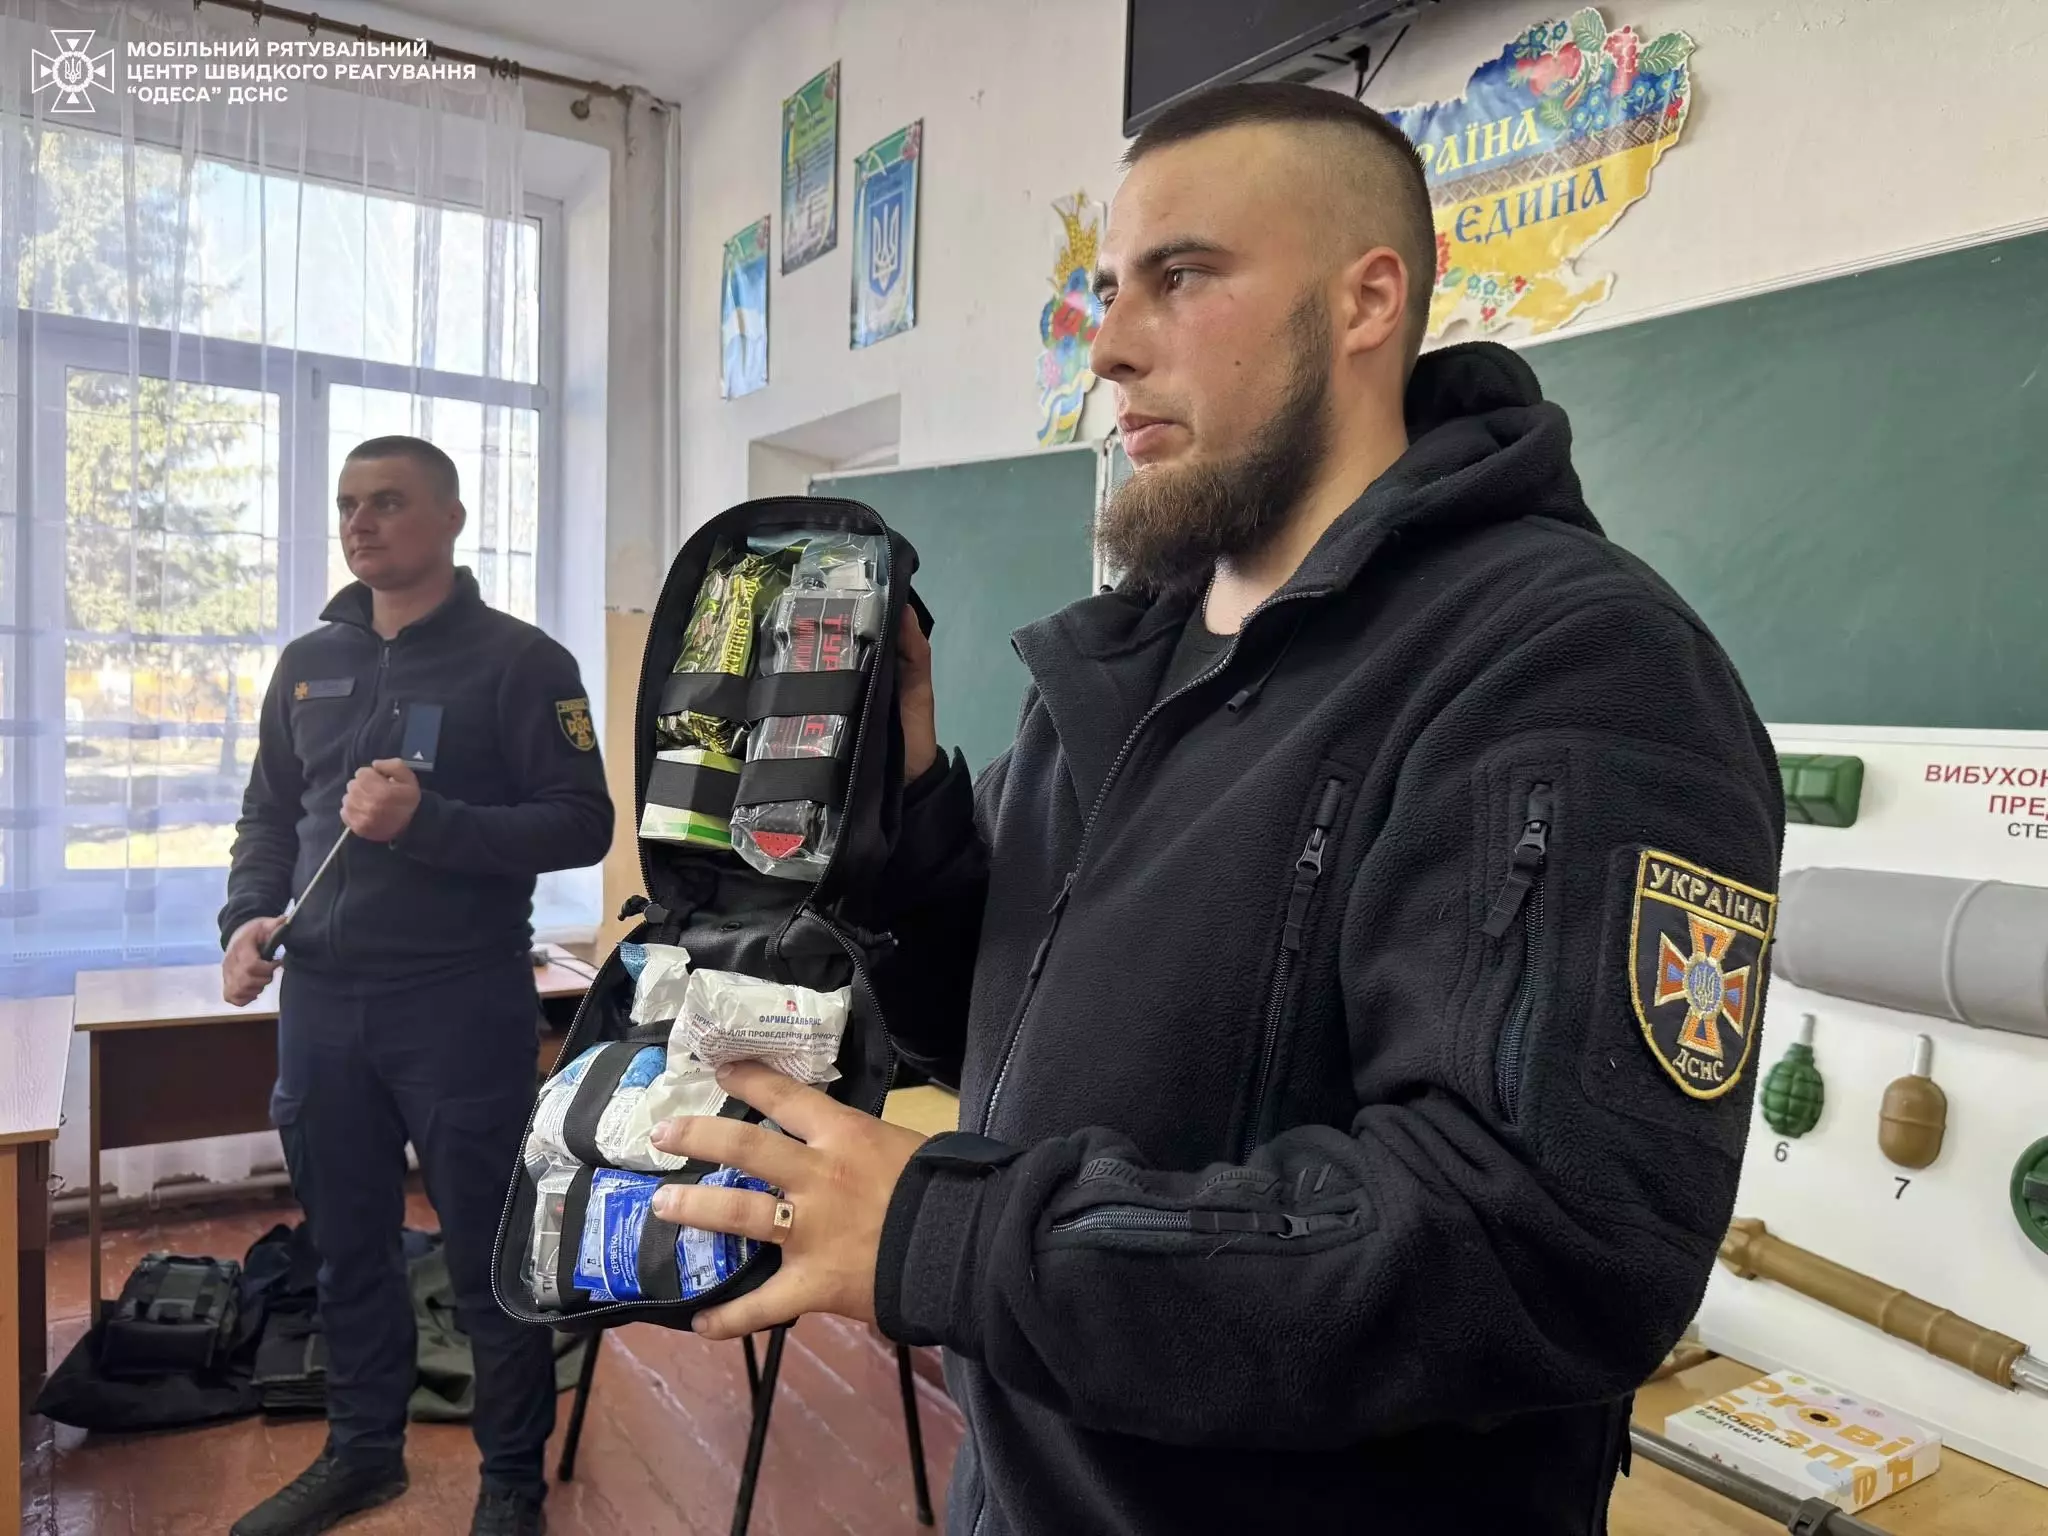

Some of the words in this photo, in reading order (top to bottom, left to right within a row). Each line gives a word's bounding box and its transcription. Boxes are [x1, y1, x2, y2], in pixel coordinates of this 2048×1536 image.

[1415, 107, 1542, 176] РАЇНА
[1455, 165, 1609, 244] ЄДИНА
[1989, 795, 2048, 821] ПРЕ
[2007, 822, 2048, 839] СТЕ
[1650, 863, 1765, 929] УКРАЇНА
[748, 1030, 802, 1040] ПРОВЕДЕННЯ
[1672, 1048, 1725, 1082] ДСНС
[1774, 1141, 1790, 1163] 6
[1895, 1176, 1911, 1200] 7
[611, 1233, 621, 1275] СЕРВЕТКА
